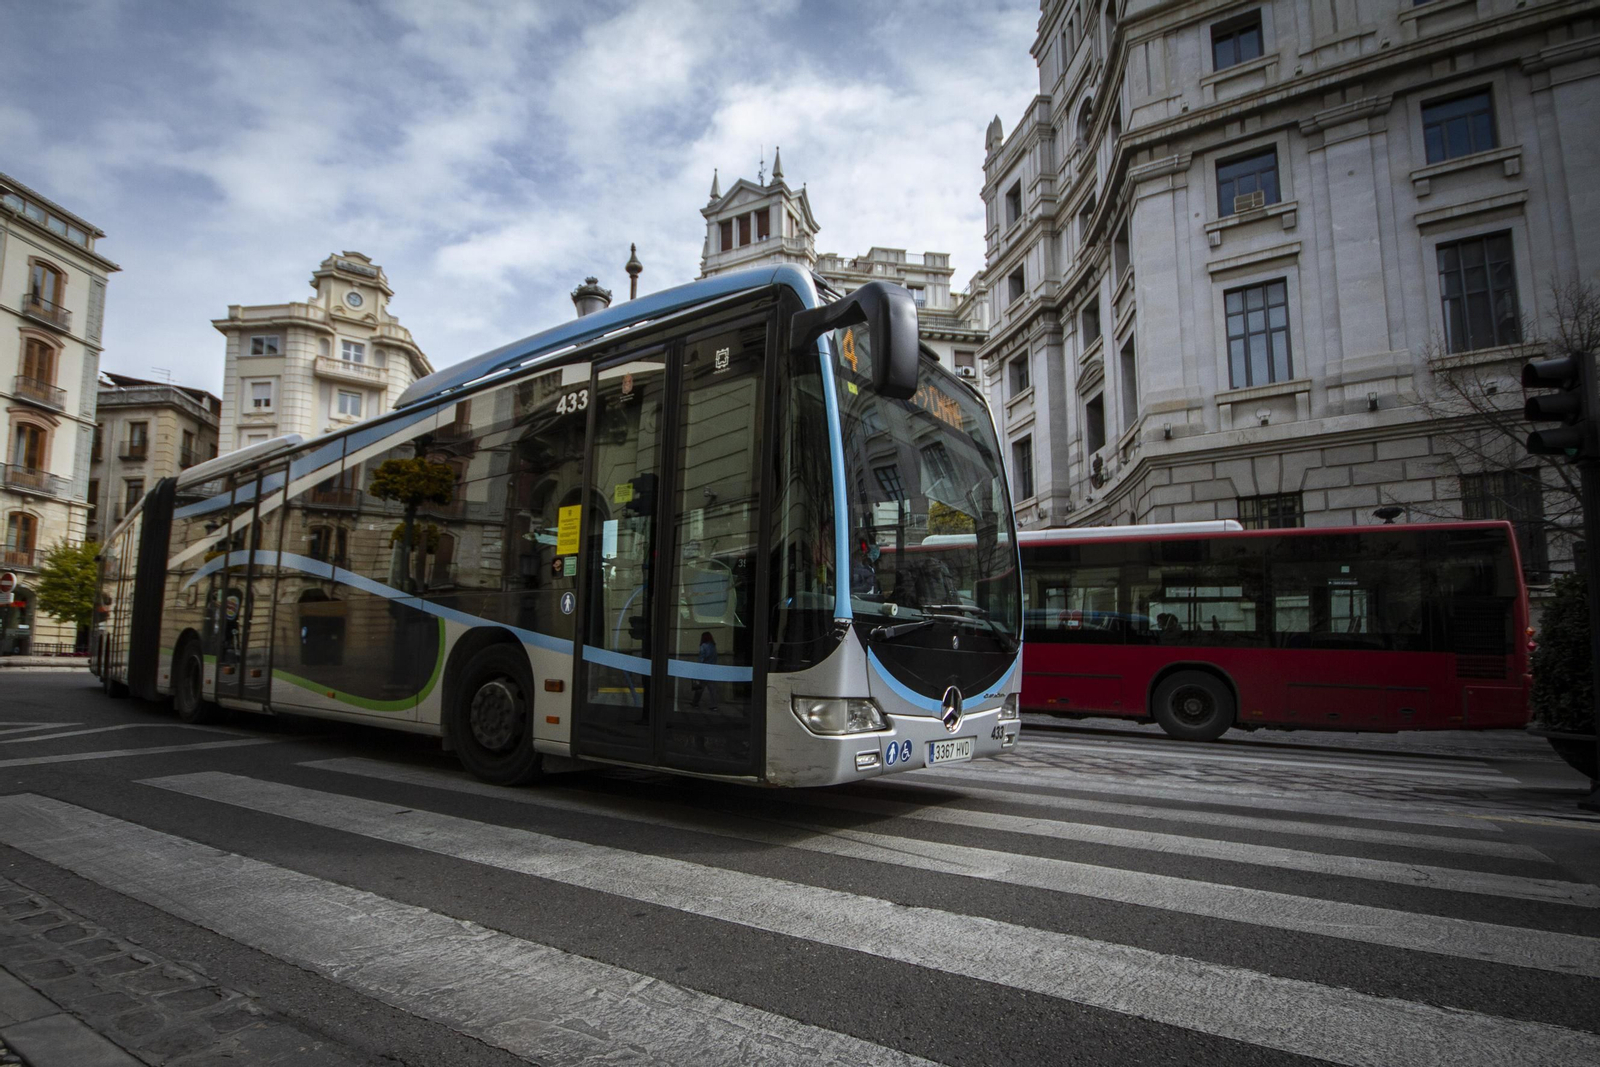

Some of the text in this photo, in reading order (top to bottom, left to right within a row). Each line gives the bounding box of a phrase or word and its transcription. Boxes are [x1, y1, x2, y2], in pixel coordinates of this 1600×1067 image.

[842, 327, 858, 372] 4
[555, 389, 588, 415] 433
[991, 725, 1004, 740] 433
[935, 741, 970, 760] 3367 HVD
